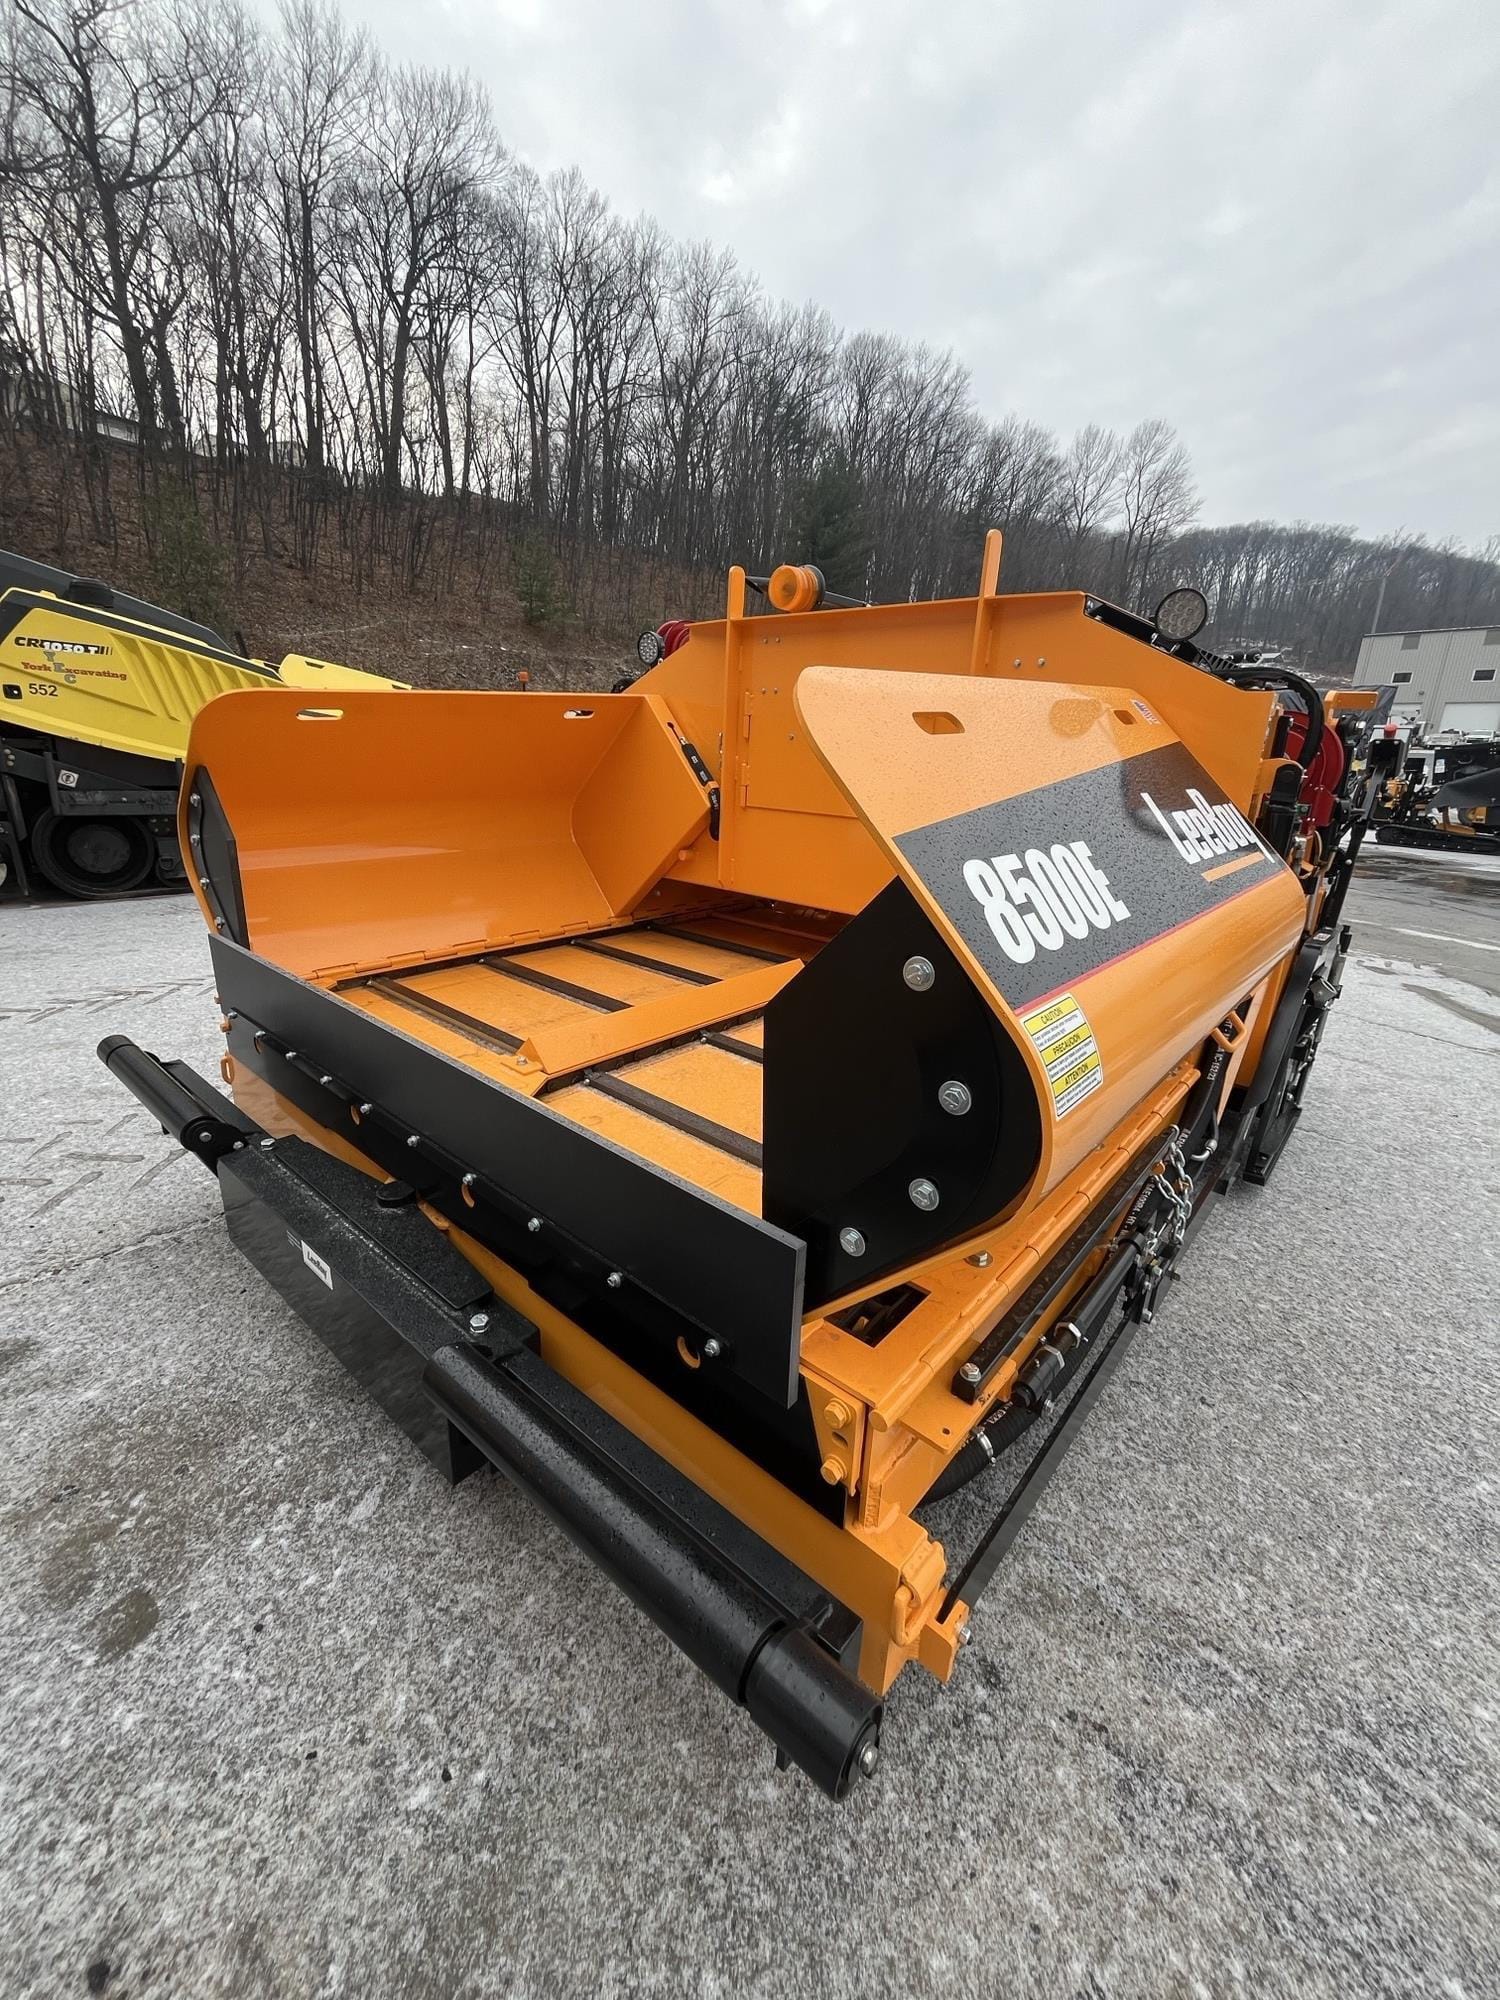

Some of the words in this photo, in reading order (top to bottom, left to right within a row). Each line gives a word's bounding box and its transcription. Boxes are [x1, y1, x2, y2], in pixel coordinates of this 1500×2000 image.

[21, 661, 52, 672] York
[53, 662, 127, 681] Excavating
[29, 683, 58, 697] 552
[1141, 788, 1276, 865] LeeBoy
[962, 840, 1131, 964] 8500E
[1040, 1007, 1065, 1025] CAUTION
[1065, 1062, 1089, 1086] ATTENTION
